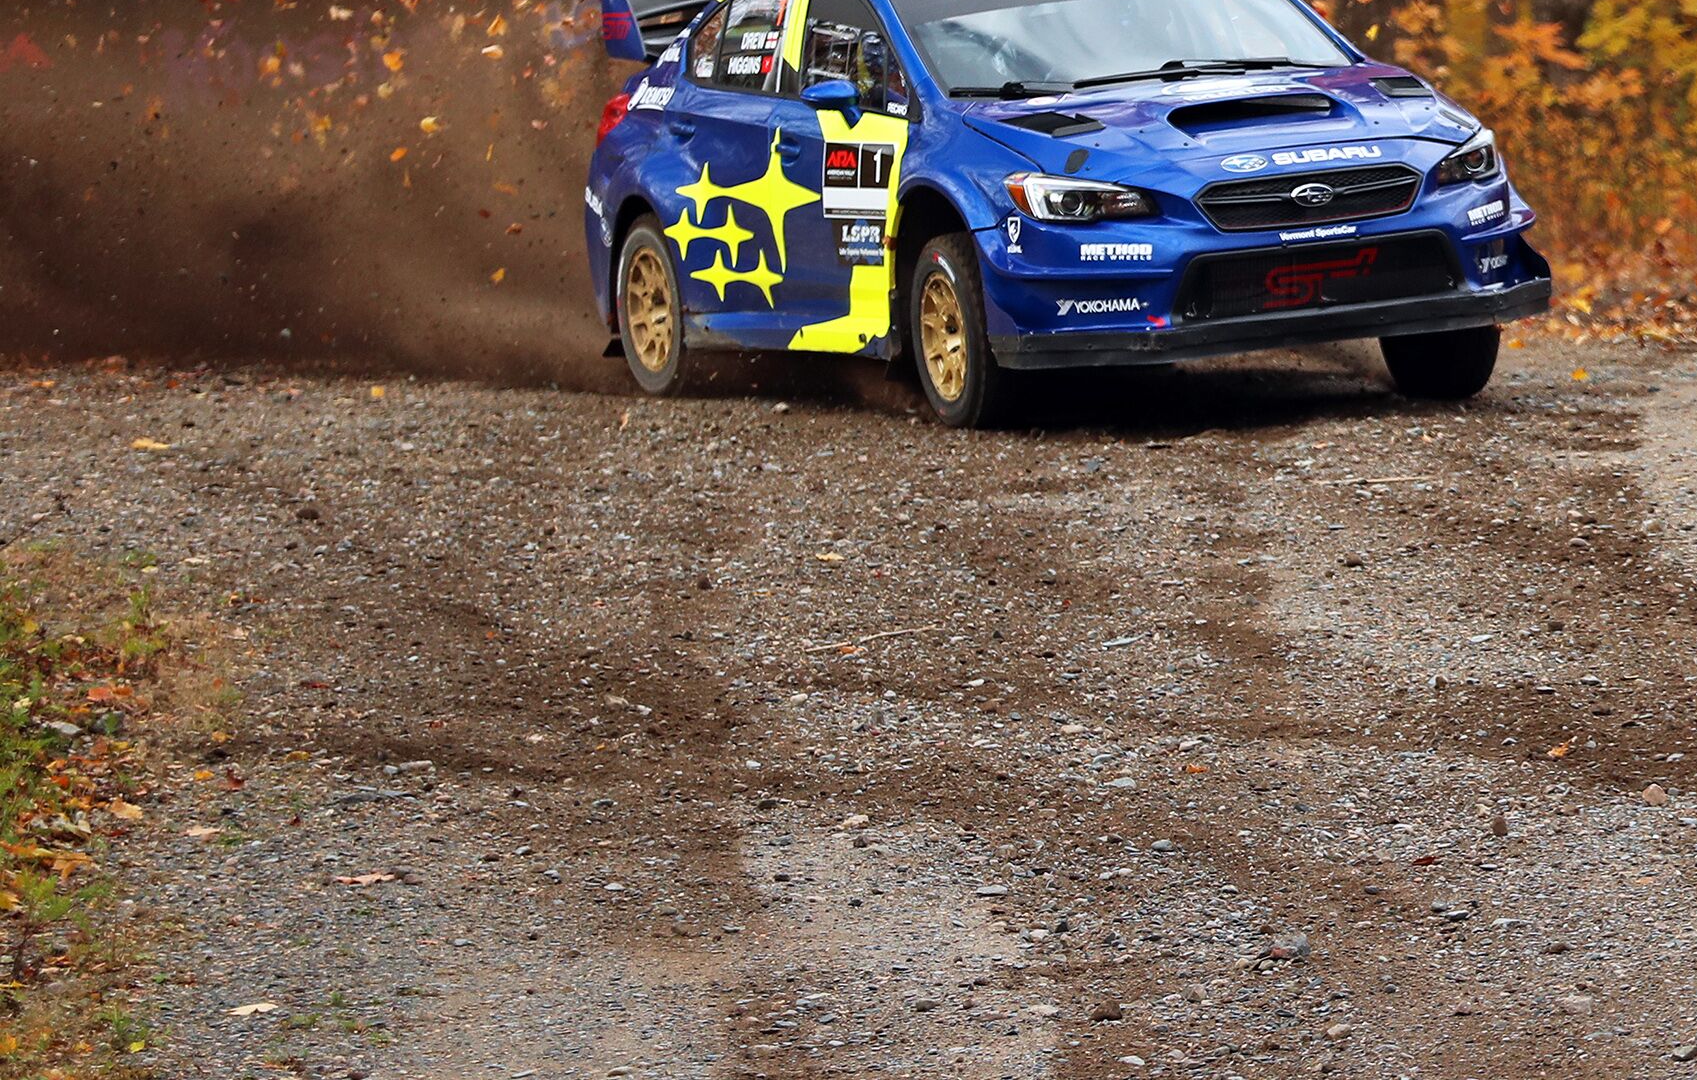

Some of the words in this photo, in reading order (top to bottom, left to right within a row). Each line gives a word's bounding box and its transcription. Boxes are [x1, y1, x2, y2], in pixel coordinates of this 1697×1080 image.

[741, 32, 768, 50] DREW
[727, 56, 762, 75] HIGGINS
[1271, 145, 1382, 166] SUBARU
[873, 148, 883, 184] 1
[1467, 200, 1503, 219] METHOD
[841, 225, 881, 243] LSPR
[1279, 228, 1315, 241] Vermont
[1315, 225, 1357, 239] SportsCar
[1080, 243, 1152, 255] METHOD
[1073, 297, 1140, 314] YOKOHAMA
